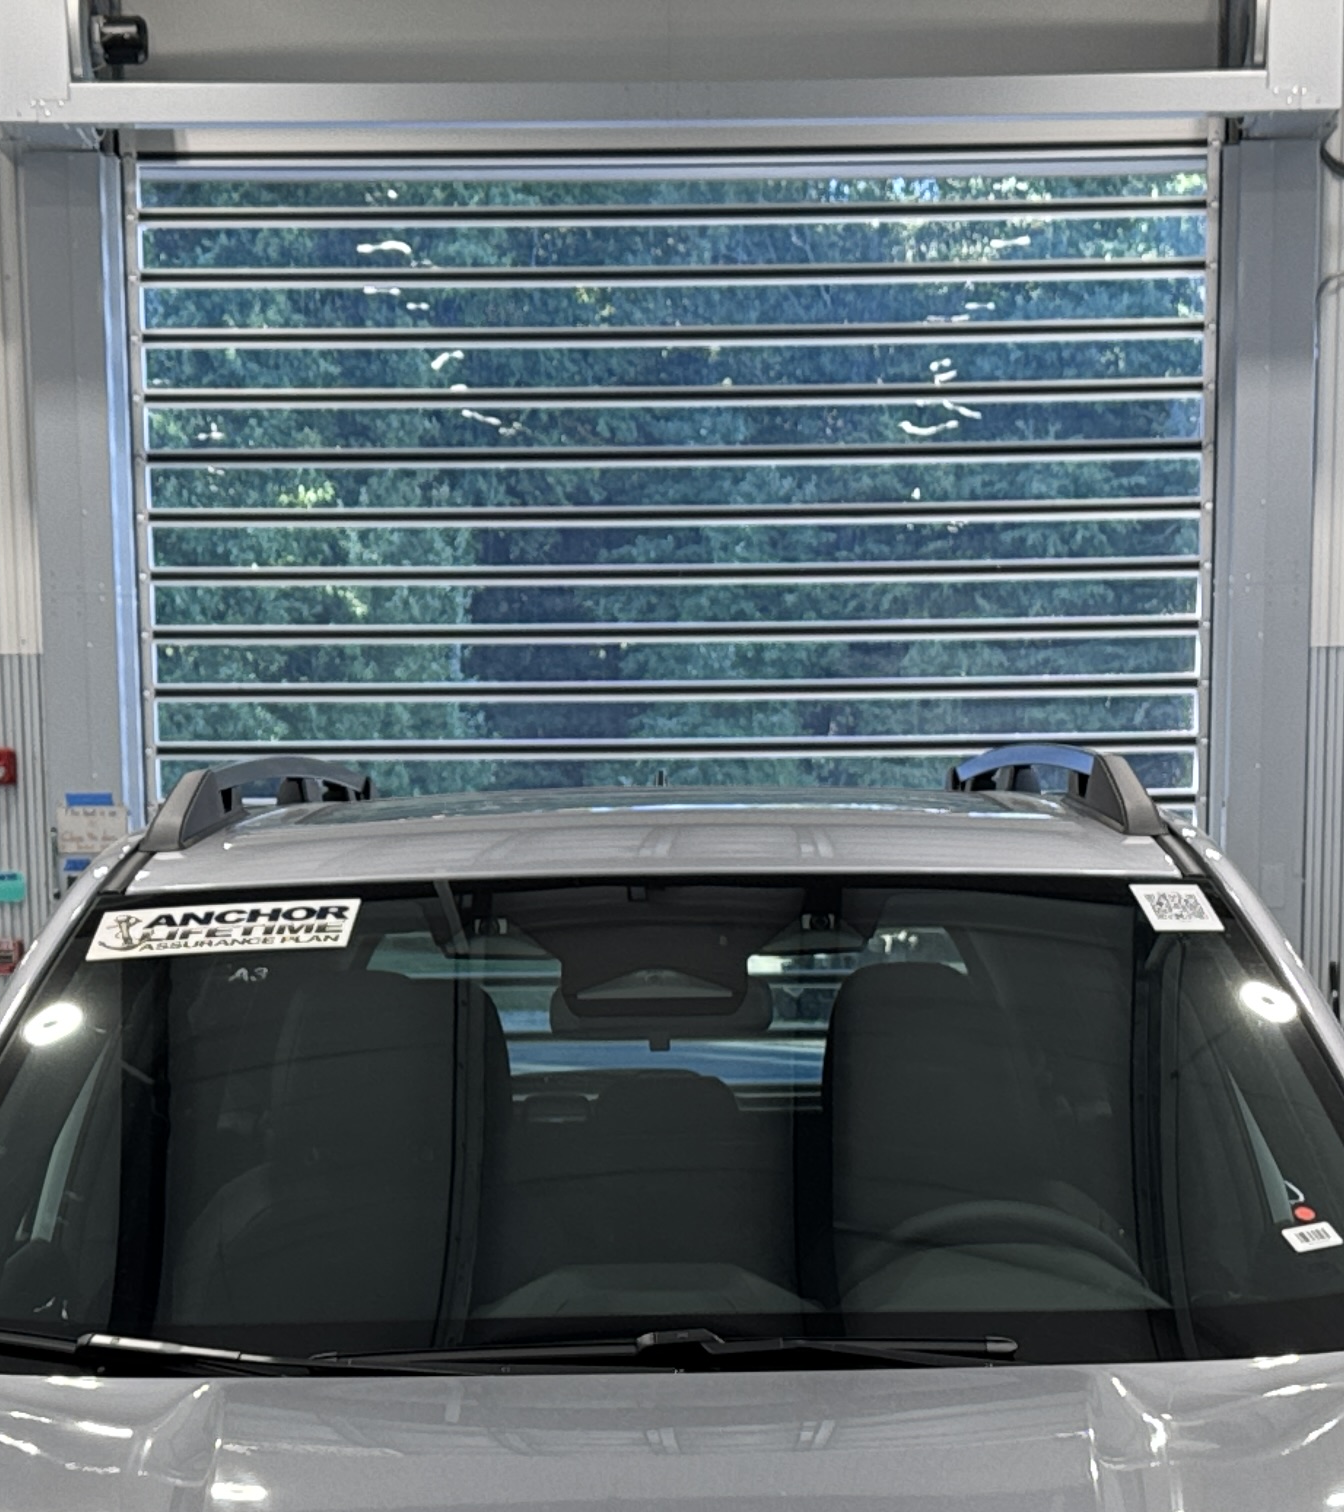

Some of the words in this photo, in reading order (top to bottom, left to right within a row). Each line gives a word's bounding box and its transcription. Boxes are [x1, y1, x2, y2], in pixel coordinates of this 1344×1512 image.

[143, 906, 350, 929] ANCHOR
[141, 922, 343, 942] LIFETIME
[280, 934, 340, 944] PLAN
[138, 936, 275, 951] ASSURANCE
